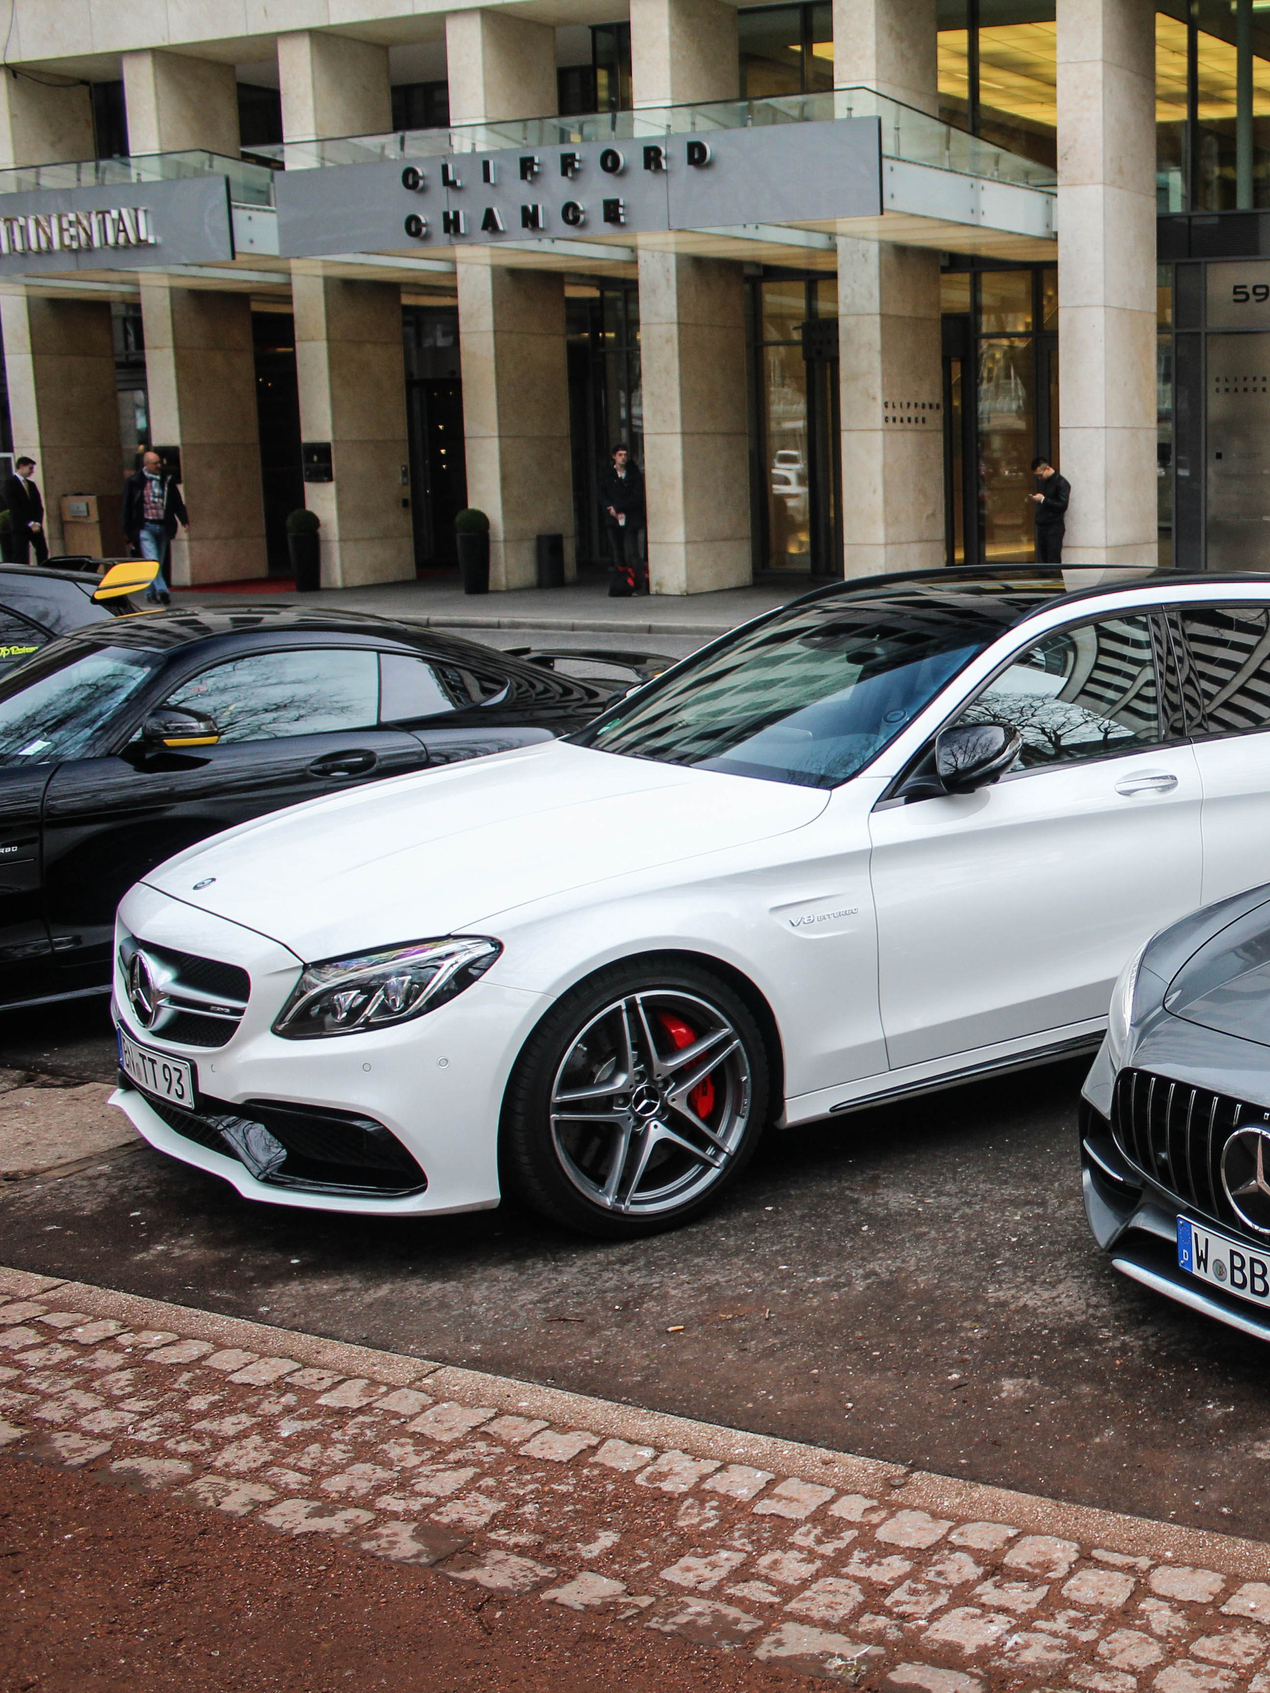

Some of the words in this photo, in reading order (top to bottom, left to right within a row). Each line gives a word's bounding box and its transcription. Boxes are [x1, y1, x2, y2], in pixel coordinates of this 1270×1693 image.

[402, 141, 711, 190] CLIFFORD
[404, 198, 626, 238] CHANCE
[1232, 284, 1270, 303] 59
[884, 401, 941, 411] CLIFFORD
[884, 416, 926, 425] CHANCE
[789, 914, 815, 927] V8
[138, 1052, 158, 1089] TT
[162, 1064, 185, 1099] 93
[1182, 1249, 1189, 1261] D
[1194, 1232, 1209, 1274] W
[1229, 1248, 1270, 1297] BB
